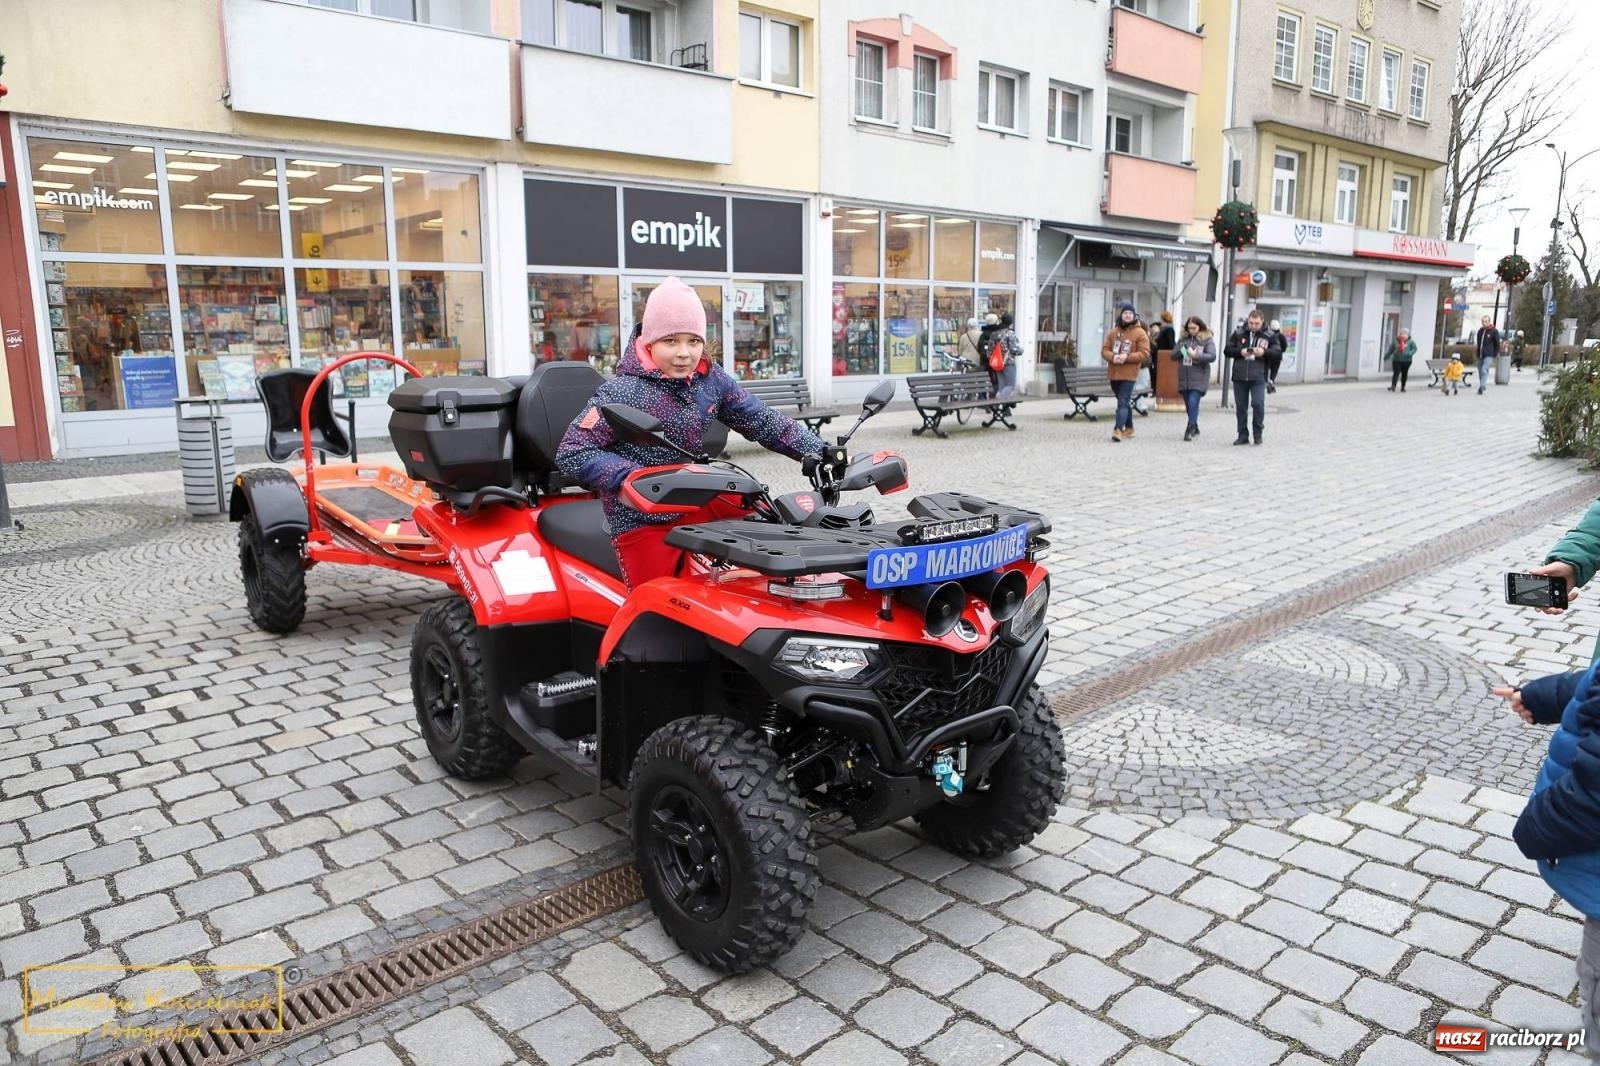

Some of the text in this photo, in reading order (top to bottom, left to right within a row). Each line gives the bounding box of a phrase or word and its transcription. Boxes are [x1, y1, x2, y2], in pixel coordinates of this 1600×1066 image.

[44, 186, 154, 210] empik.com
[631, 212, 722, 252] empik
[1308, 225, 1322, 238] TEB
[981, 247, 1016, 261] empik.com
[1393, 235, 1448, 257] ROSSMANN
[892, 341, 914, 357] 15%
[872, 528, 1026, 585] OSP MARKOWICE
